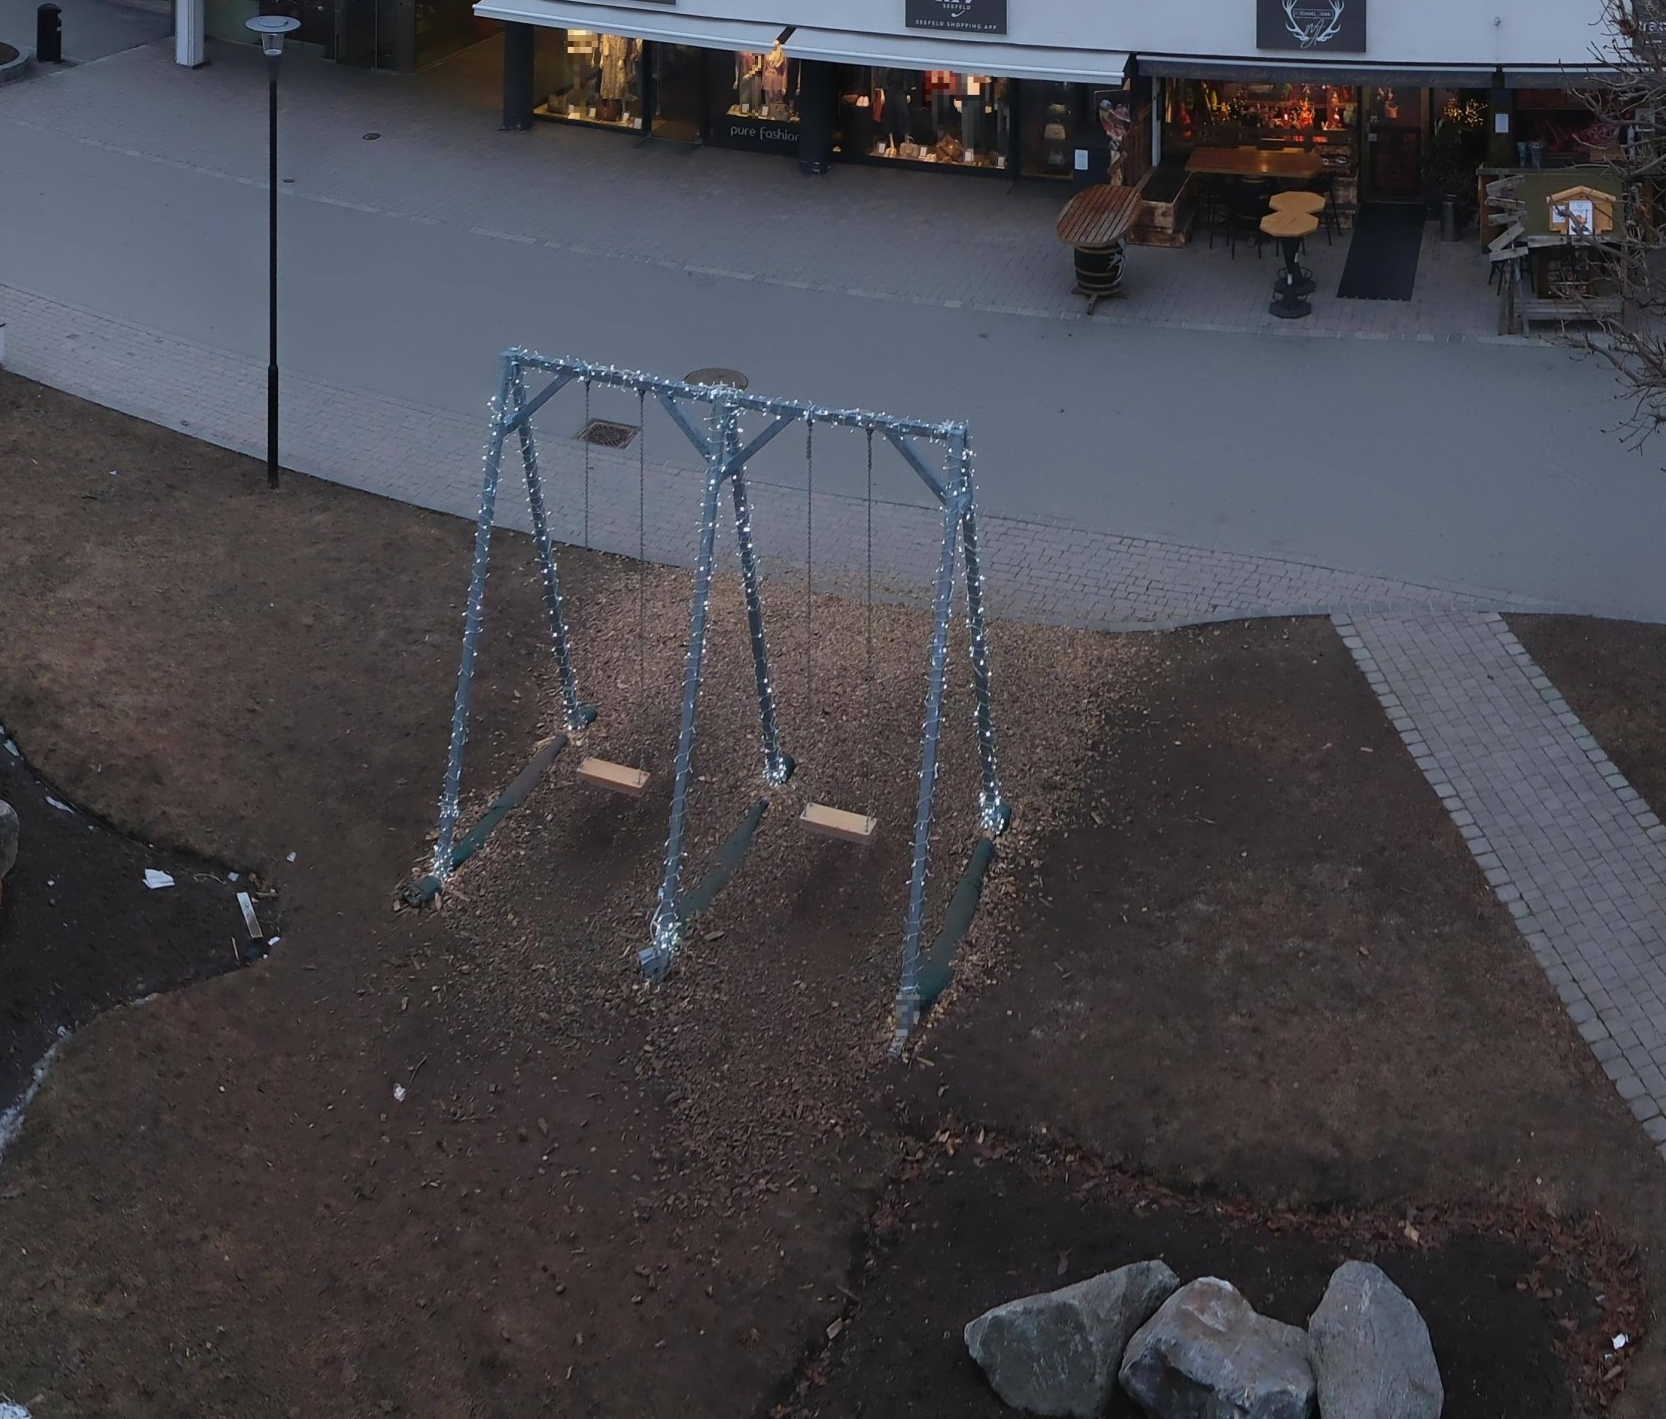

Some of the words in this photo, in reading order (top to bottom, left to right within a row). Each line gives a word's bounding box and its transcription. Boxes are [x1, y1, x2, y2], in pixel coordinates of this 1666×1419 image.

[915, 19, 944, 27] SEEFELD
[946, 21, 982, 29] SHOPPING
[730, 126, 756, 137] pure
